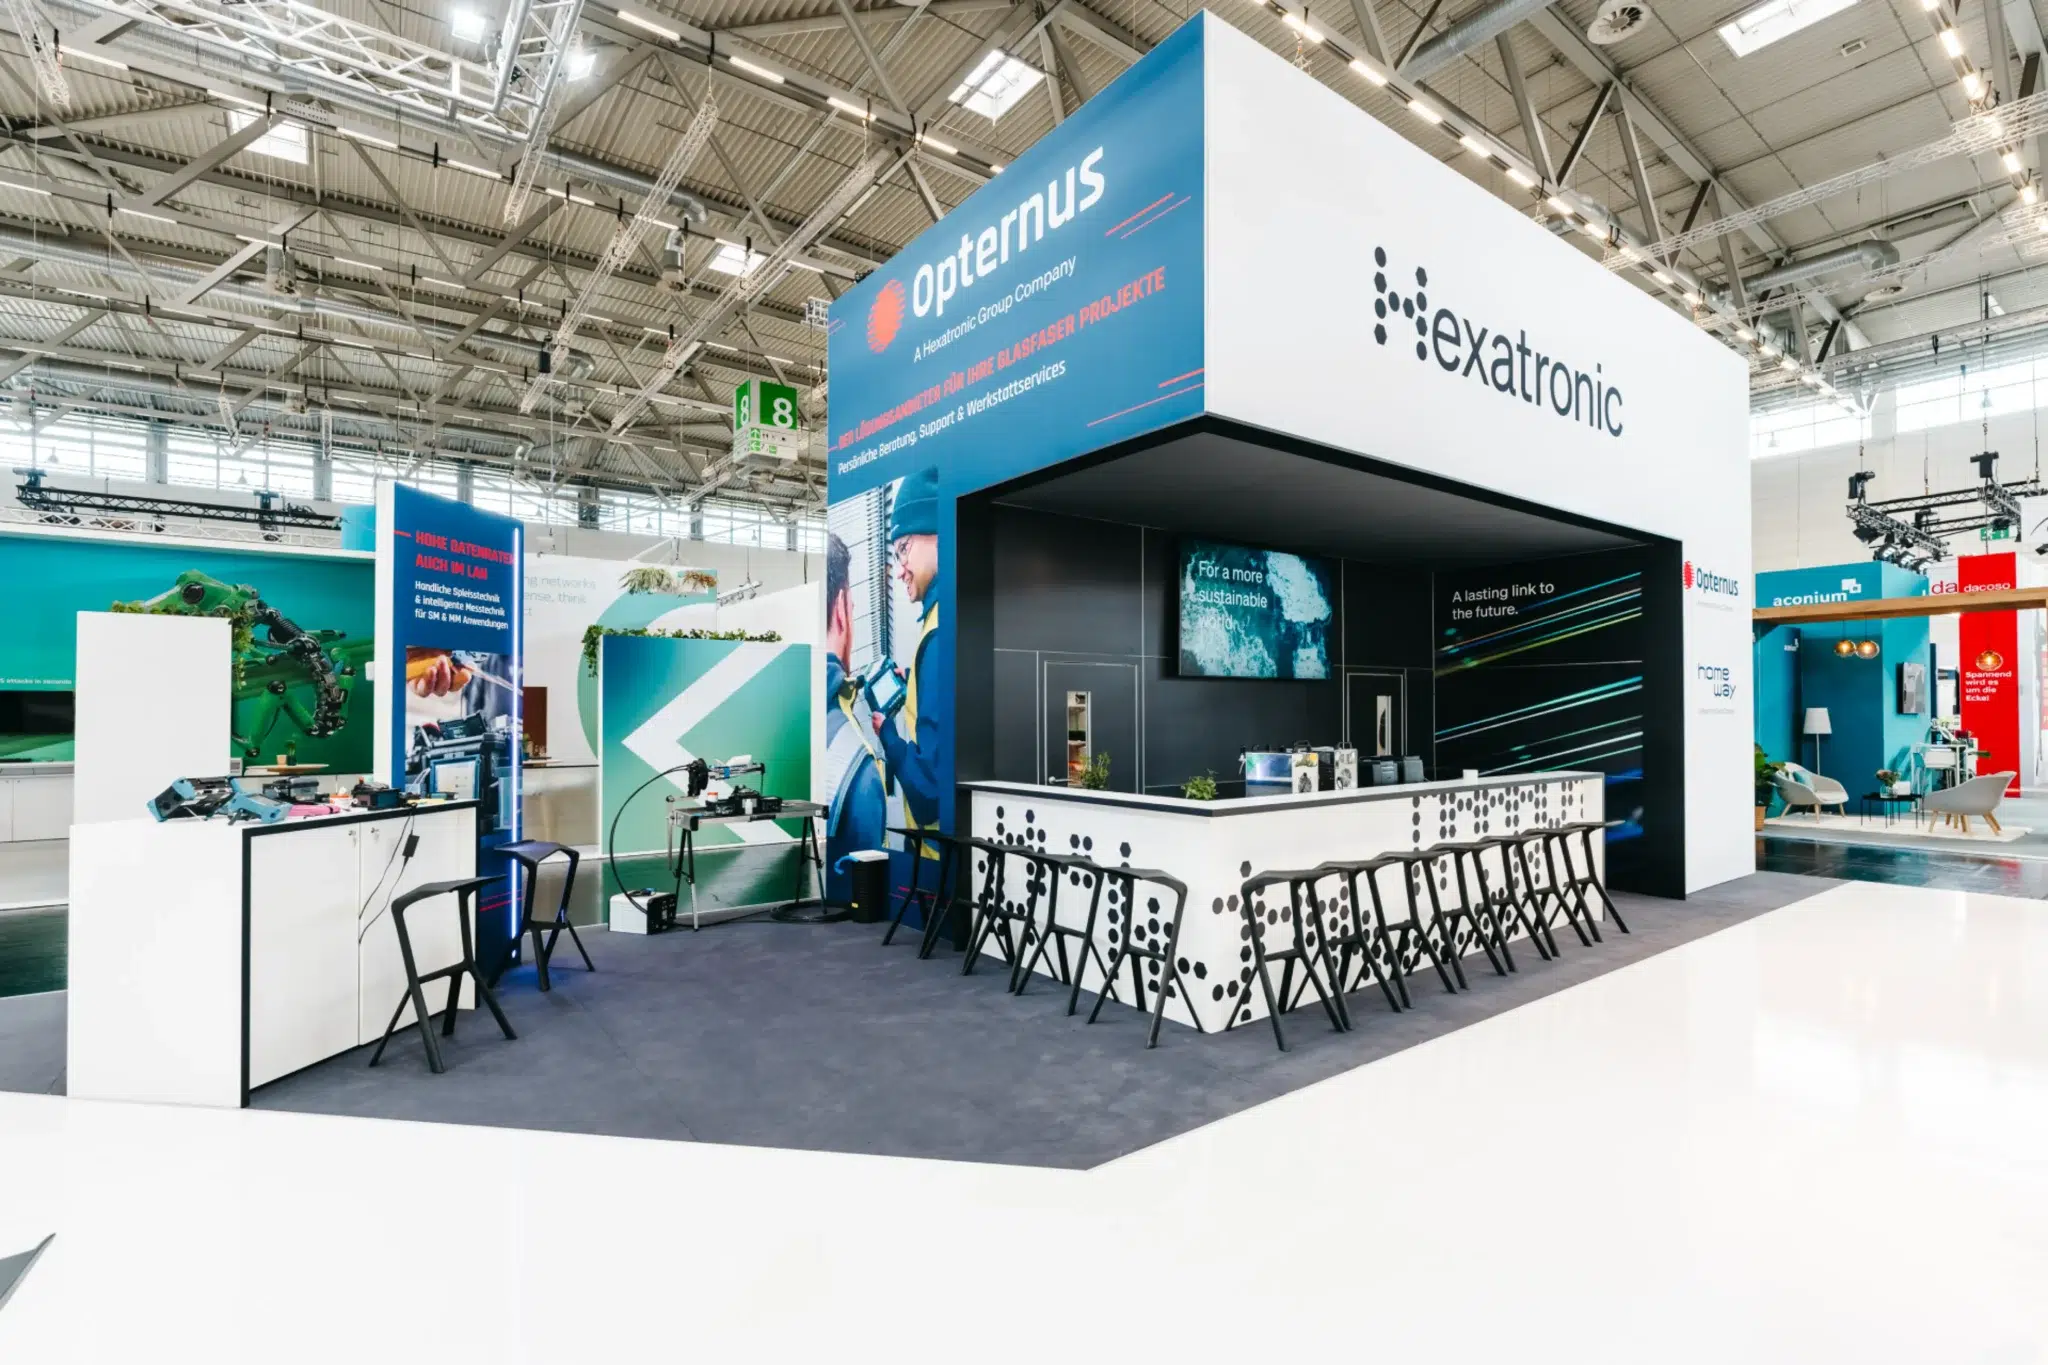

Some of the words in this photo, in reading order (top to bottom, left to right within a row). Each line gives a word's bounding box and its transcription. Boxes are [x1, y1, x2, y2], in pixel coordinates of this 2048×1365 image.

[912, 146, 1105, 318] Opternus
[914, 346, 922, 363] A
[923, 316, 976, 358] Hexatronic
[978, 294, 1013, 325] Group
[1015, 255, 1076, 303] Company
[1374, 246, 1624, 437] Hexatronic
[838, 429, 853, 450] DER
[855, 384, 941, 442] LÖSUNGSANBIETER
[943, 371, 965, 397] FÜR
[967, 355, 995, 386] IHRE
[997, 313, 1076, 371] GLASFASER
[1079, 265, 1166, 329] PROJEKTE
[773, 398, 793, 428] 8
[838, 448, 878, 476] Persönliche
[879, 430, 917, 458] Beratung,
[919, 410, 955, 440] Support
[957, 406, 965, 422] &
[966, 359, 1067, 418] Werkstattservices
[416, 531, 448, 551] HOHE
[415, 553, 448, 572] AUCH
[451, 560, 465, 576] IM
[467, 563, 488, 581] LAN
[1199, 560, 1220, 579] For
[1221, 566, 1230, 580] a
[1232, 568, 1264, 584] more
[415, 580, 452, 595] Handliche
[453, 586, 501, 604] Spleisstechnik
[1452, 591, 1462, 603] A
[1464, 587, 1509, 602] lasting
[1511, 582, 1537, 597] link
[1539, 582, 1555, 594] to
[1696, 567, 1739, 597] Opternus
[1963, 582, 2011, 593] dacoso
[415, 594, 421, 605] &
[422, 595, 464, 610] intelligente
[465, 602, 506, 617] Messtechnik
[1198, 588, 1269, 609] sustainable
[1773, 591, 1848, 606] aconium
[415, 608, 426, 619] für
[427, 610, 440, 621] SM
[441, 613, 448, 622] &
[448, 613, 462, 625] MM
[463, 616, 509, 631] Anwendungen
[1452, 608, 1473, 621] the
[1475, 604, 1519, 619] future.
[1697, 663, 1730, 681] home
[1965, 671, 2013, 679] Spannend
[1713, 683, 1737, 700] way
[1982, 686, 1997, 694] die
